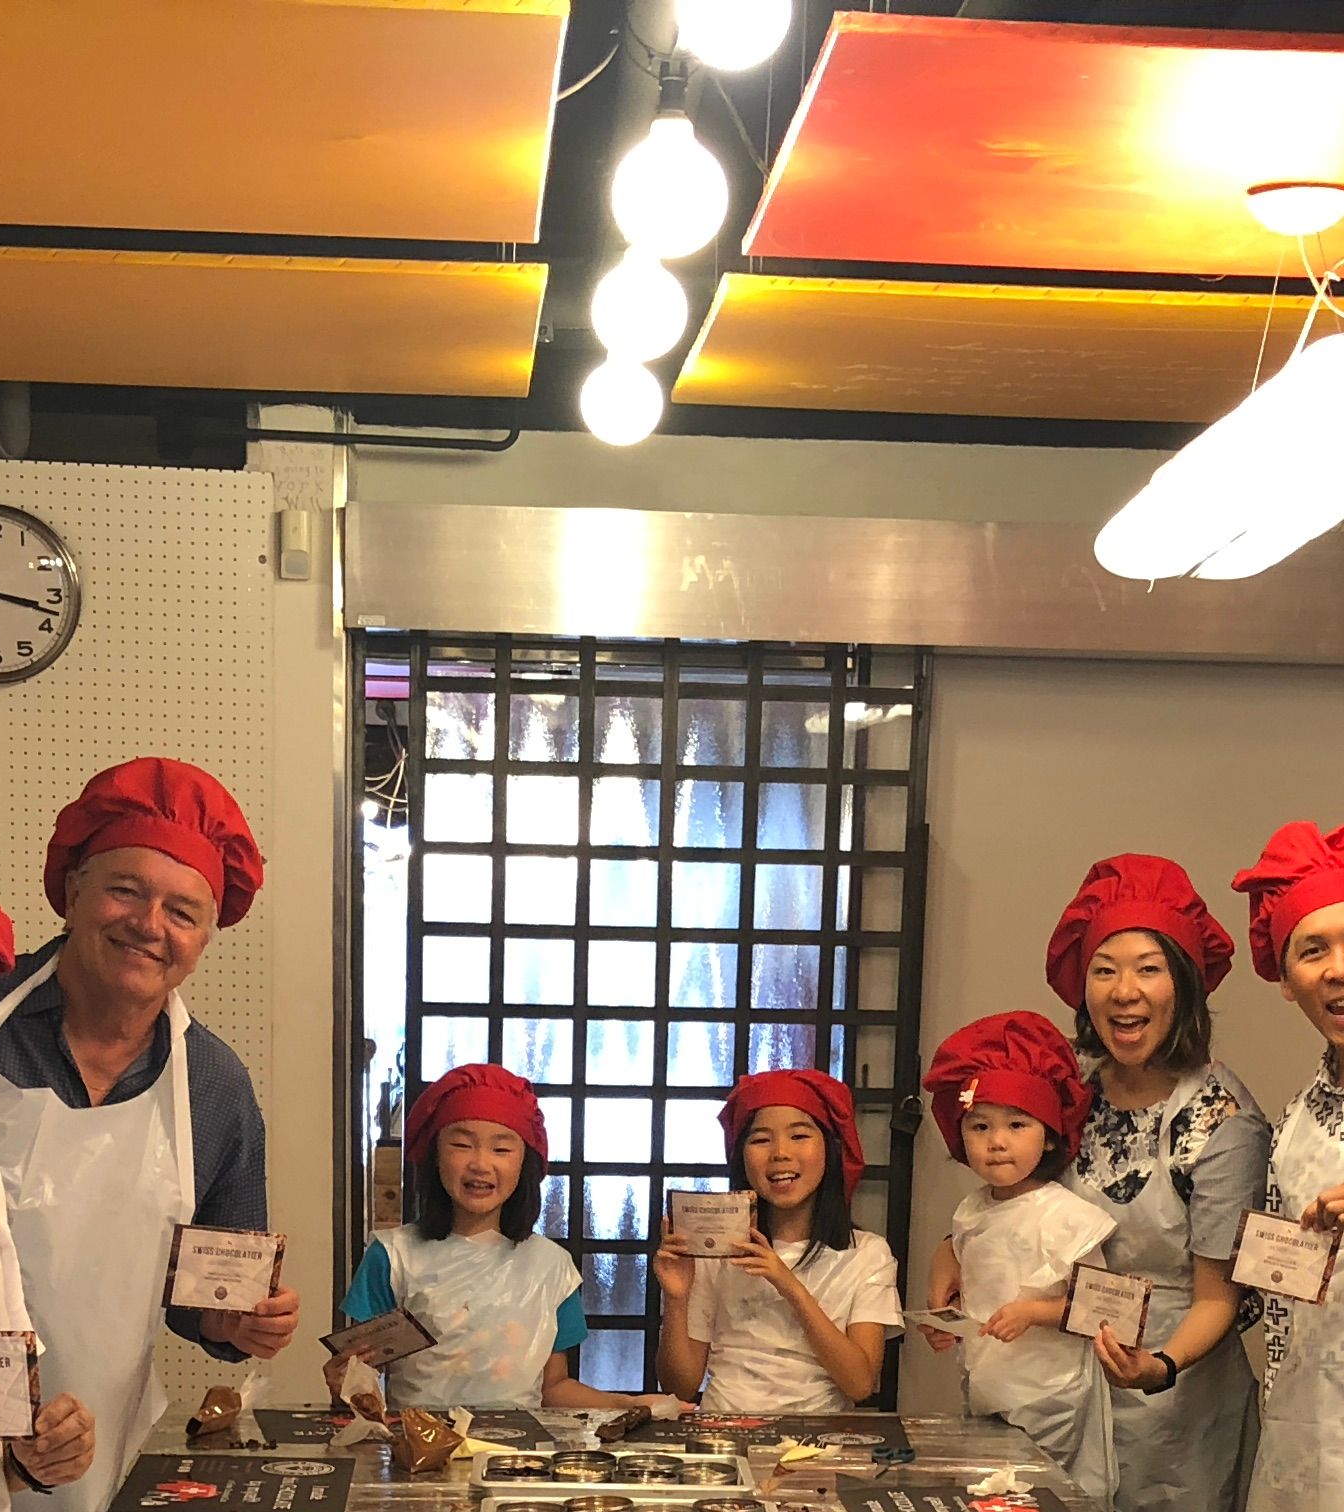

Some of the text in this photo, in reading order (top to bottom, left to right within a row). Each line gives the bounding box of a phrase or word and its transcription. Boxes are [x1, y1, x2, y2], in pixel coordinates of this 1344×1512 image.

[20, 530, 24, 546] 1
[46, 588, 62, 604] 3
[38, 618, 53, 633] 4
[17, 641, 34, 656] 5
